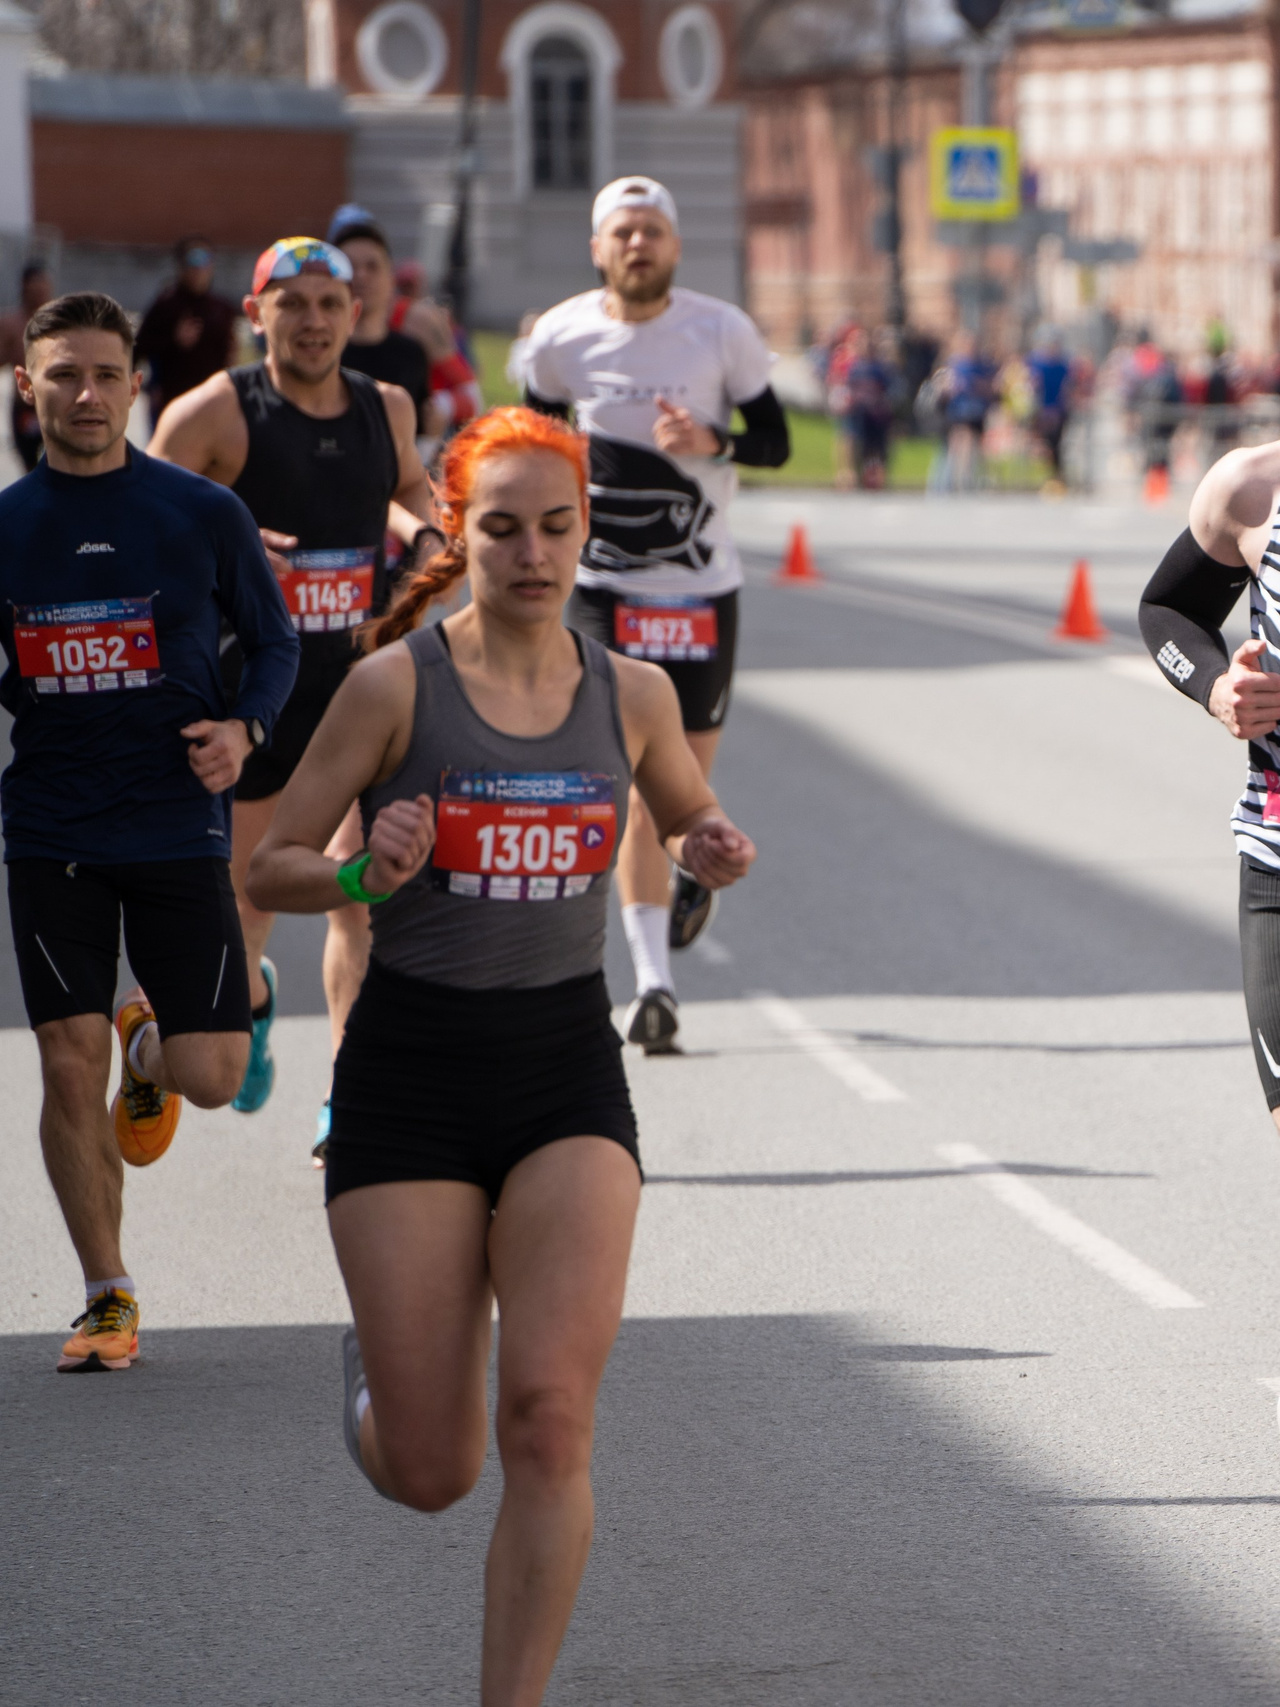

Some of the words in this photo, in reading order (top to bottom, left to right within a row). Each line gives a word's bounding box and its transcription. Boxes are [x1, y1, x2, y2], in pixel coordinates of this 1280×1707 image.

[76, 542, 115, 554] JÖGEL
[295, 581, 352, 614] 1145
[65, 625, 95, 635] АНТОН
[46, 635, 129, 673] 1052
[508, 778, 566, 788] ПРОСТО
[496, 786, 566, 799] КОСМОС
[503, 806, 548, 818] КСЕНИЯ
[476, 824, 579, 872] 1305
